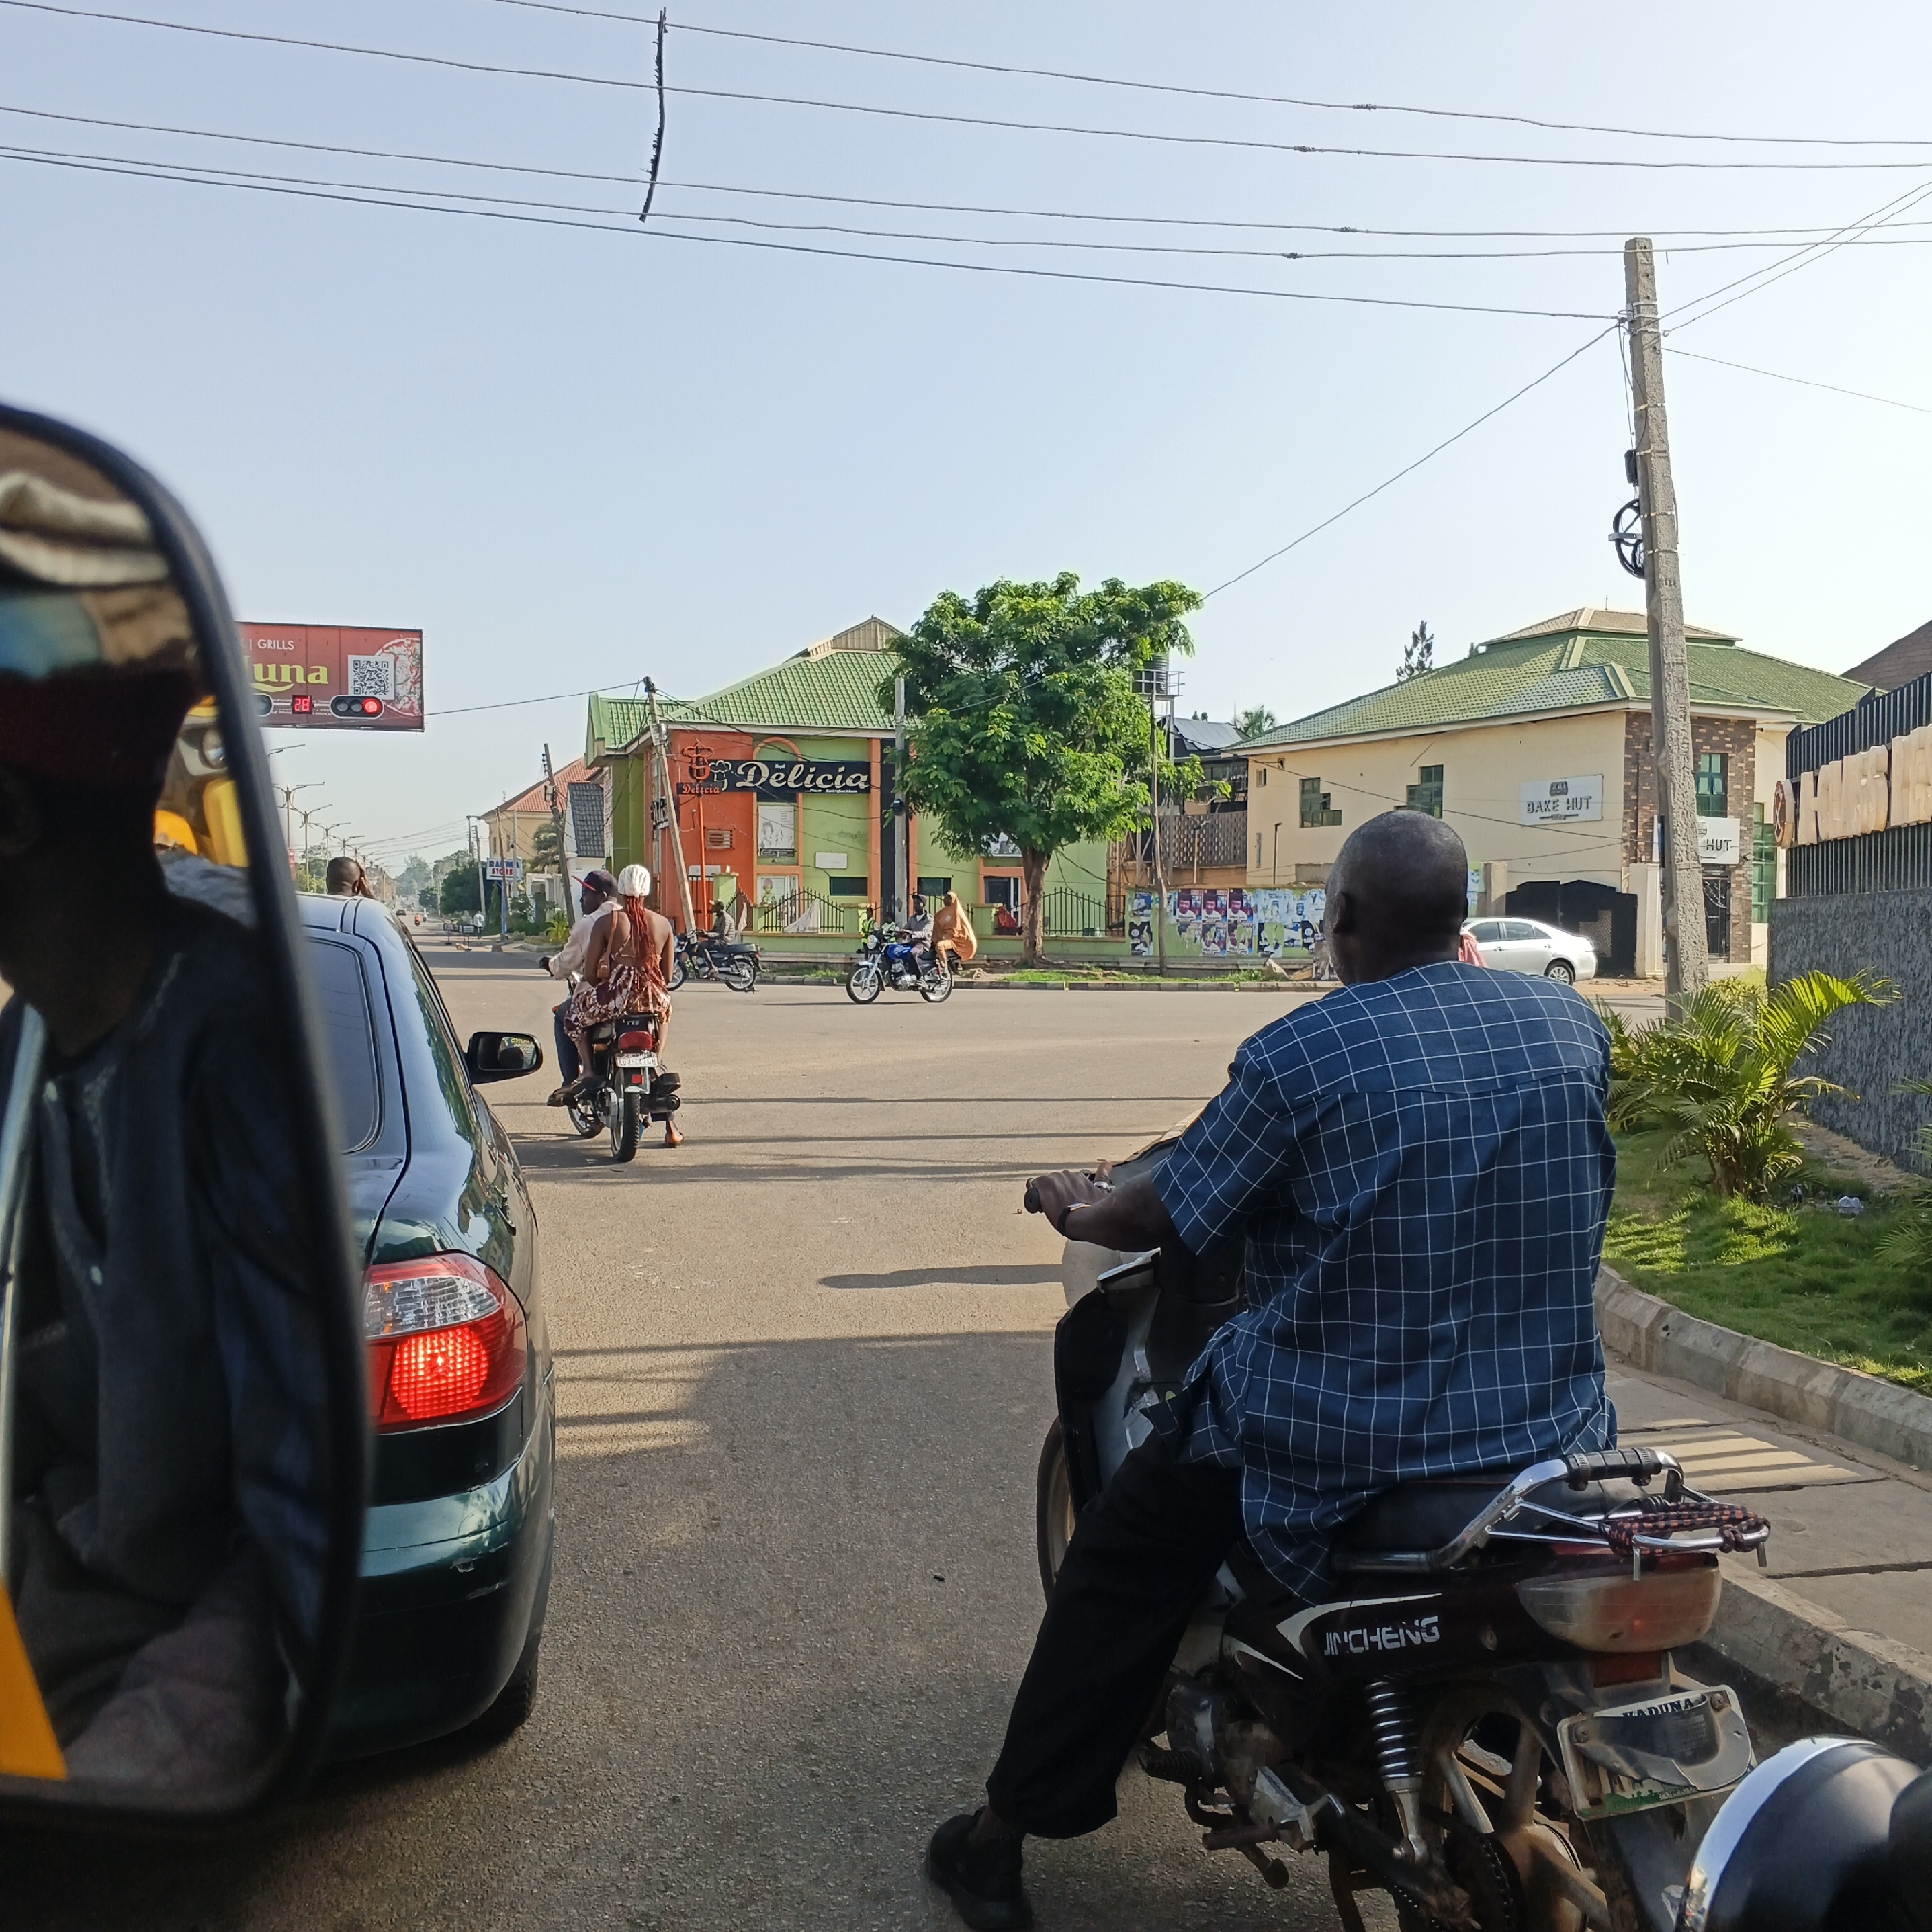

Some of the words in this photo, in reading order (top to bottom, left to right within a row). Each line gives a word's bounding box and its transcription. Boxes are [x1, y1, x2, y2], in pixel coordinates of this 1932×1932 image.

[257, 639, 295, 651] GRILLS
[245, 656, 329, 685] una
[736, 761, 869, 790] Delicia
[682, 783, 721, 794] Delicia
[1527, 798, 1560, 814] BAKE
[1566, 795, 1592, 810] HUT
[1706, 838, 1732, 851] HUT
[1324, 1615, 1440, 1656] JINCHENG
